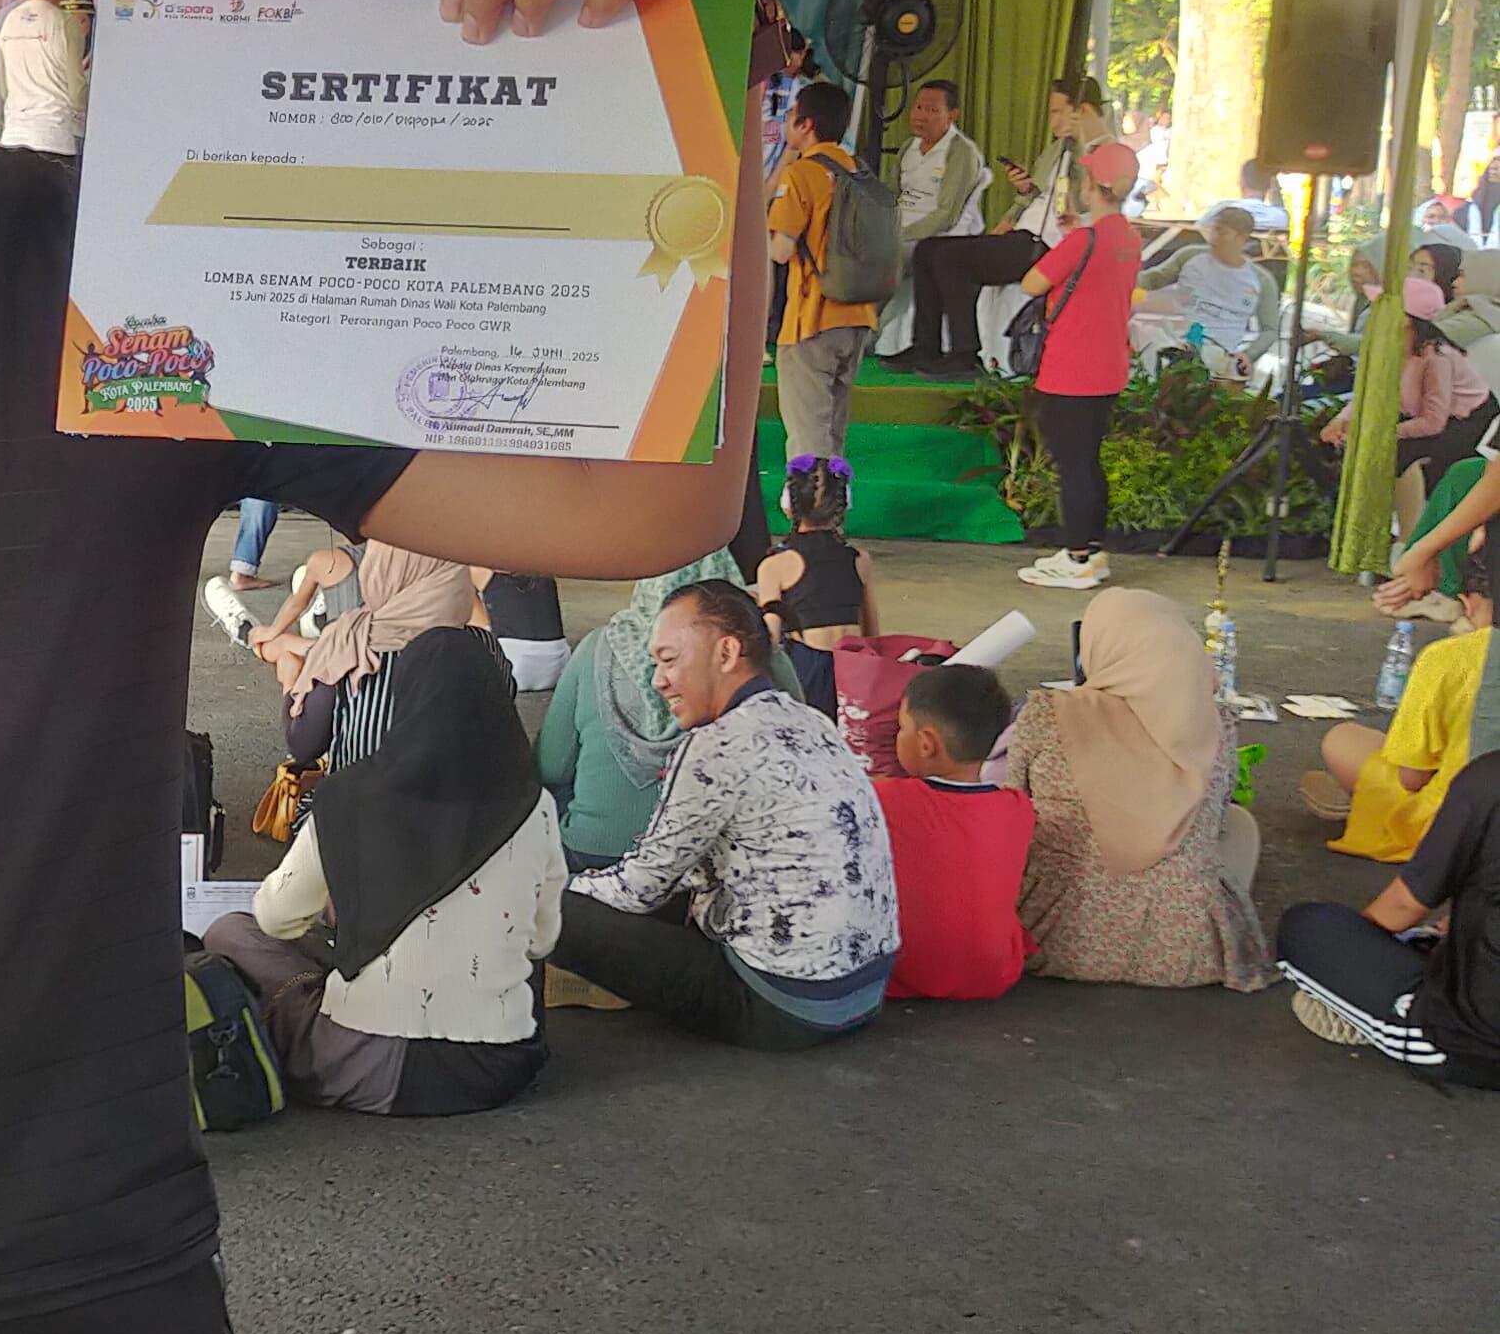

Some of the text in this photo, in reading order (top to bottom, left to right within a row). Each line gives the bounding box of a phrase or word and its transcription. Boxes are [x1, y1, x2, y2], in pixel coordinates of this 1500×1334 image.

[261, 70, 558, 107] SERTIFIKAT
[268, 111, 317, 125] NOMOR
[186, 149, 199, 161] Di
[203, 150, 248, 163] berikan
[250, 150, 298, 166] kepada
[361, 237, 416, 254] Sebagai
[204, 271, 592, 299] LOMBA SENAM POCO-POCO KOTA PALEMBANG 2025
[229, 290, 547, 316] 15 Juni 2025 di Halaman Rumah Dinas Wali Kota Palembang
[280, 311, 512, 332] Kategori Perorangan Poco Poco GWR
[104, 328, 191, 357] Senam
[532, 346, 563, 359] JUNI
[571, 351, 600, 363] 2025
[474, 362, 502, 372] Dinas
[126, 396, 158, 413] 2025
